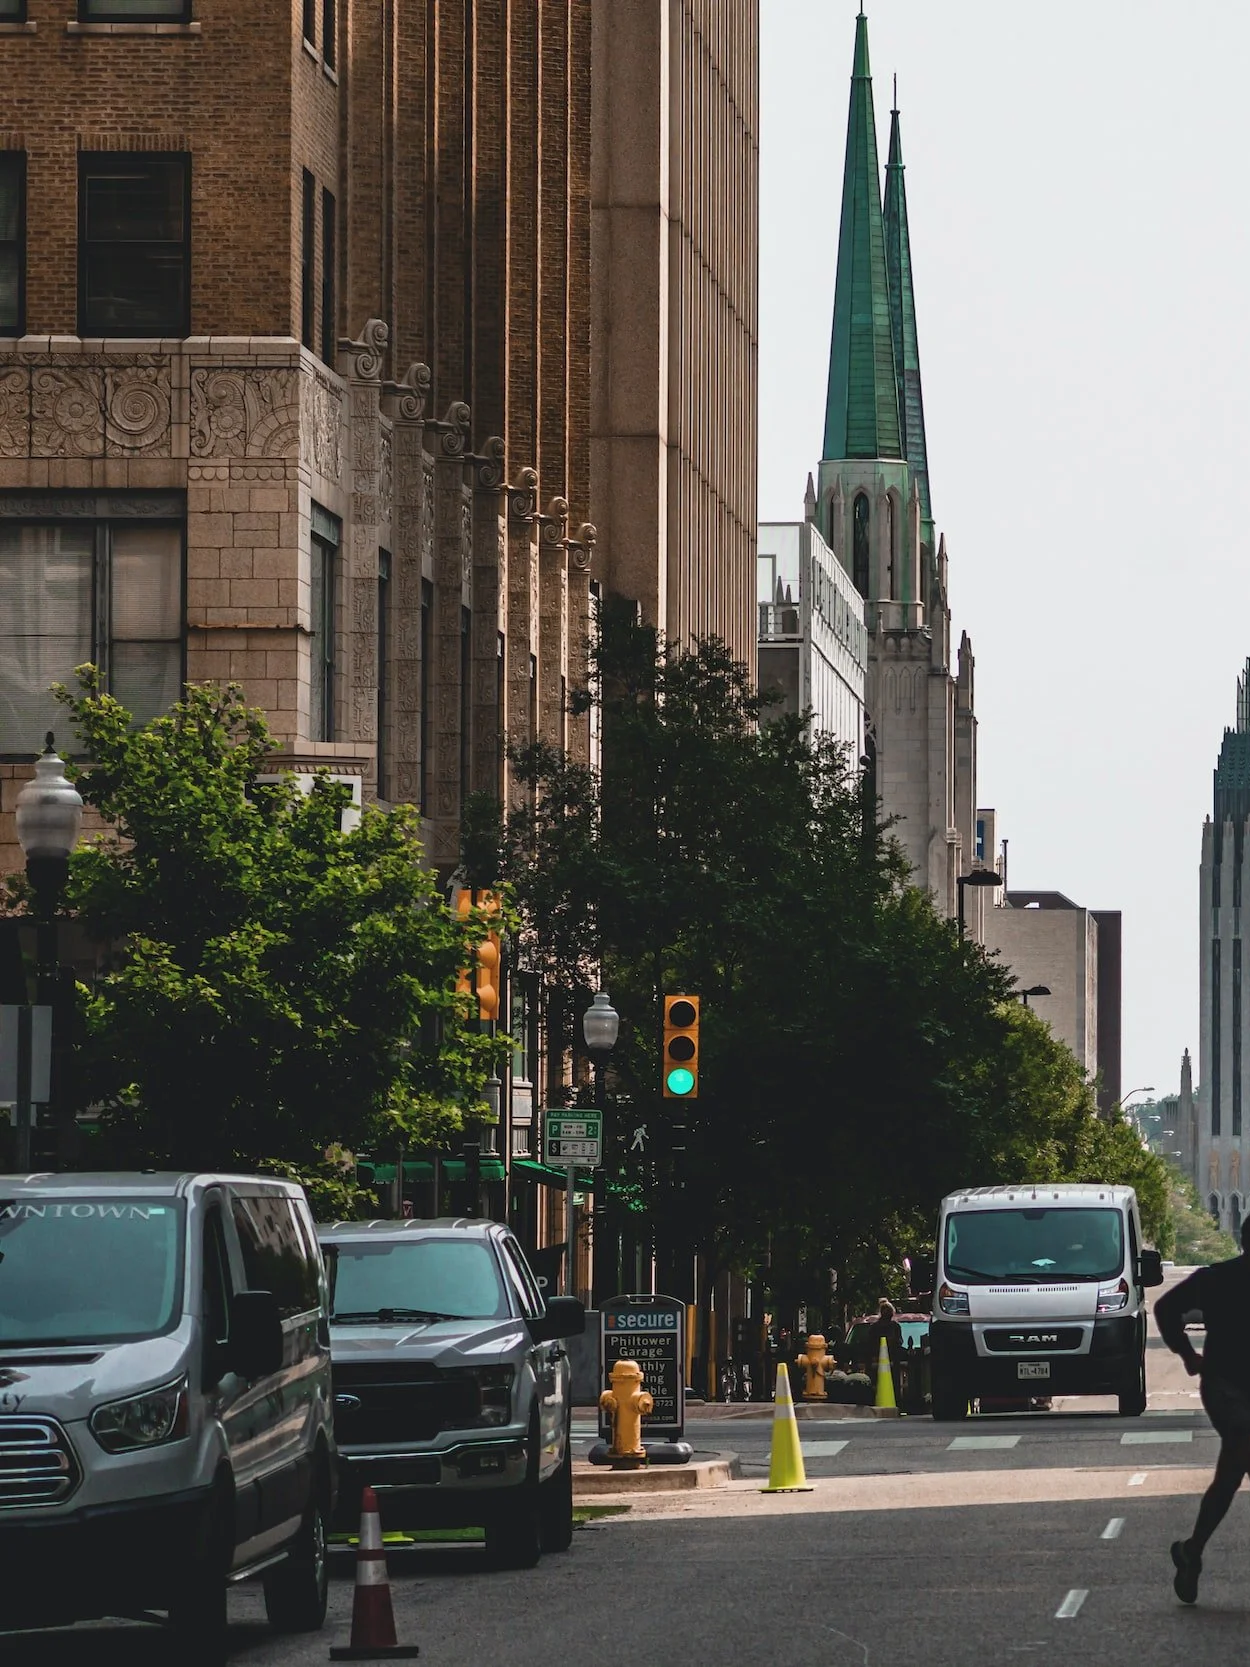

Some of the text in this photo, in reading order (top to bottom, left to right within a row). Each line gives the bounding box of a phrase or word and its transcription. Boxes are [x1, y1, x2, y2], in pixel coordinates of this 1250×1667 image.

[551, 1124, 558, 1134] P
[0, 1204, 150, 1219] WNTOWN
[617, 1313, 675, 1328] secure
[610, 1336, 671, 1346] Philtower
[619, 1346, 663, 1357] Garage
[2, 1391, 27, 1411] ty
